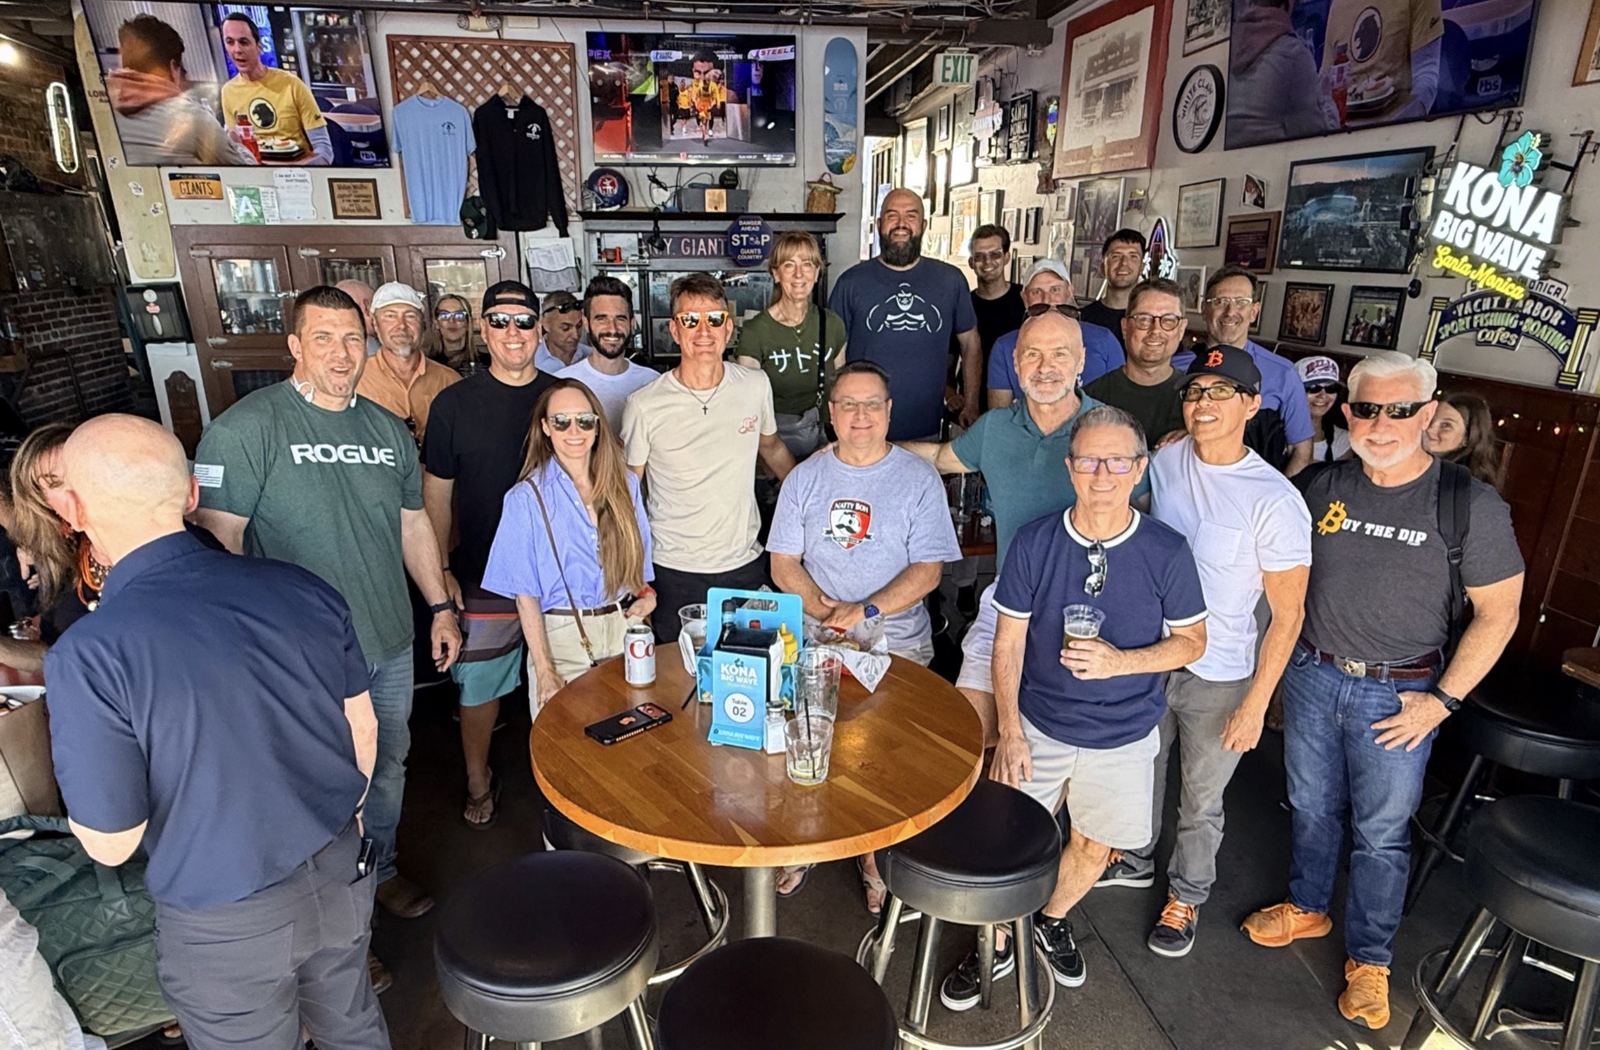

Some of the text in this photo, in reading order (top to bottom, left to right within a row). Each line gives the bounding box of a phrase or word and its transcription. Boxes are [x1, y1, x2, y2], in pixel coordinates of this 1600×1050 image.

[941, 55, 974, 83] EXIT
[178, 181, 214, 196] GIANTS
[238, 195, 259, 217] A
[1443, 161, 1563, 244] KONA
[680, 238, 728, 256] GIANT
[1432, 209, 1547, 281] BIG WAVE
[1432, 244, 1526, 300] Santa Monica
[1456, 297, 1501, 317] YACHT
[1438, 311, 1572, 355] SPORT FISHING BOATING
[290, 444, 396, 467] ROGUE
[1363, 522, 1396, 540] THE
[1396, 527, 1428, 547] DIP
[719, 663, 758, 679] KONA
[735, 676, 759, 687] WAVE
[732, 705, 748, 718] 02
